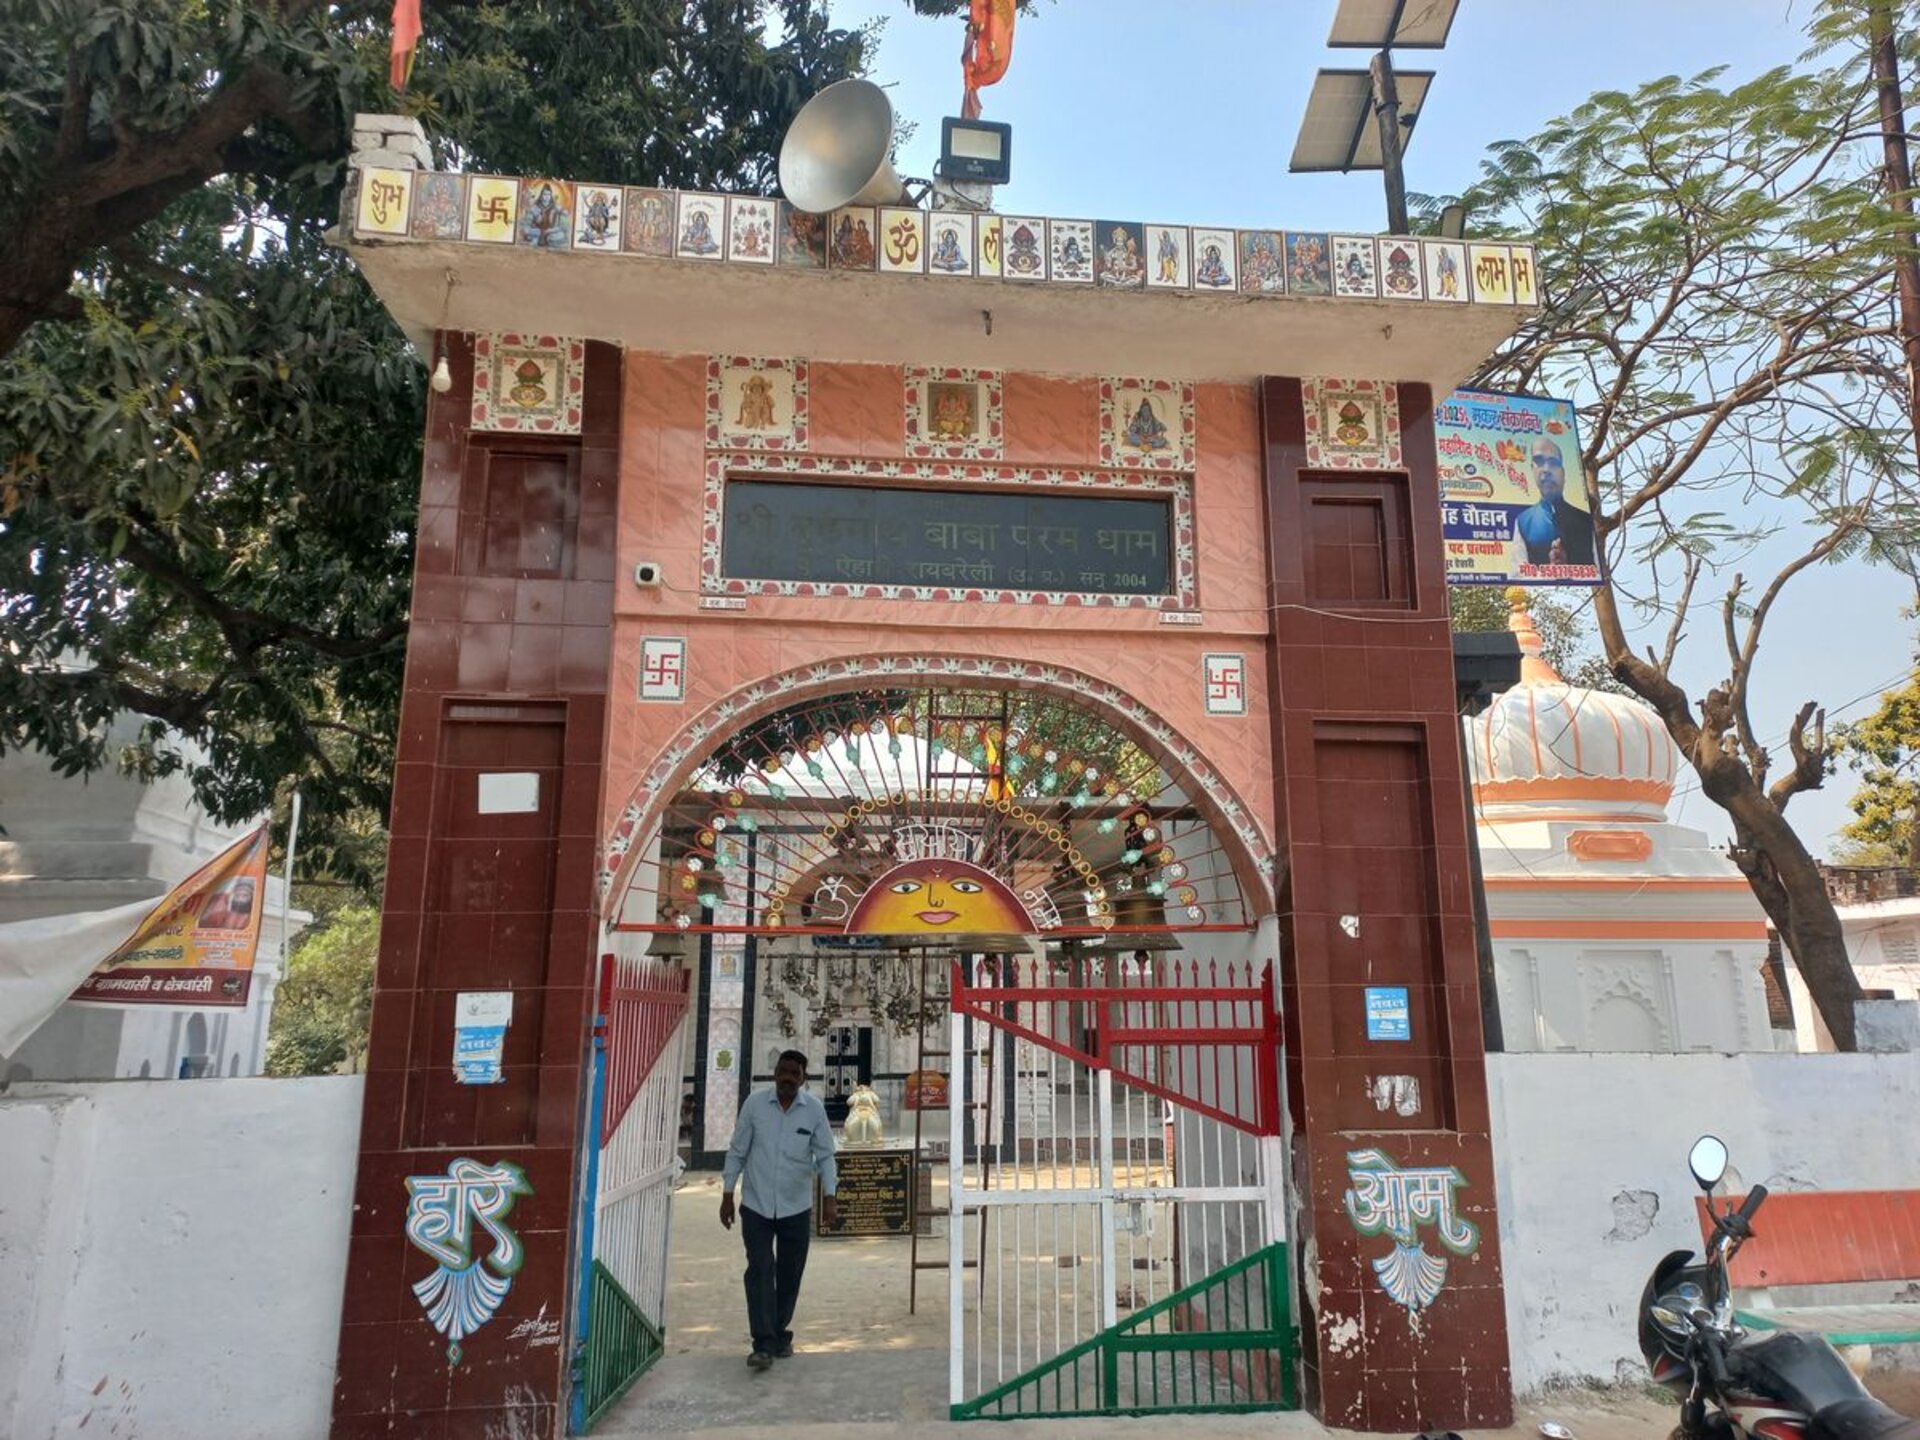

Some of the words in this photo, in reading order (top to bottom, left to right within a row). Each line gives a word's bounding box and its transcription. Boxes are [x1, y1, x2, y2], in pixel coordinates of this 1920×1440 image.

[371, 179, 405, 225] शुभ
[1477, 256, 1506, 293] लाभ
[1462, 504, 1508, 527] चौहान
[924, 521, 1000, 552] बाबा
[1011, 525, 1080, 555] परम
[1096, 528, 1158, 558] धाम
[1448, 543, 1463, 555] पद
[1113, 573, 1147, 587] 2004
[406, 1160, 526, 1270] हरि
